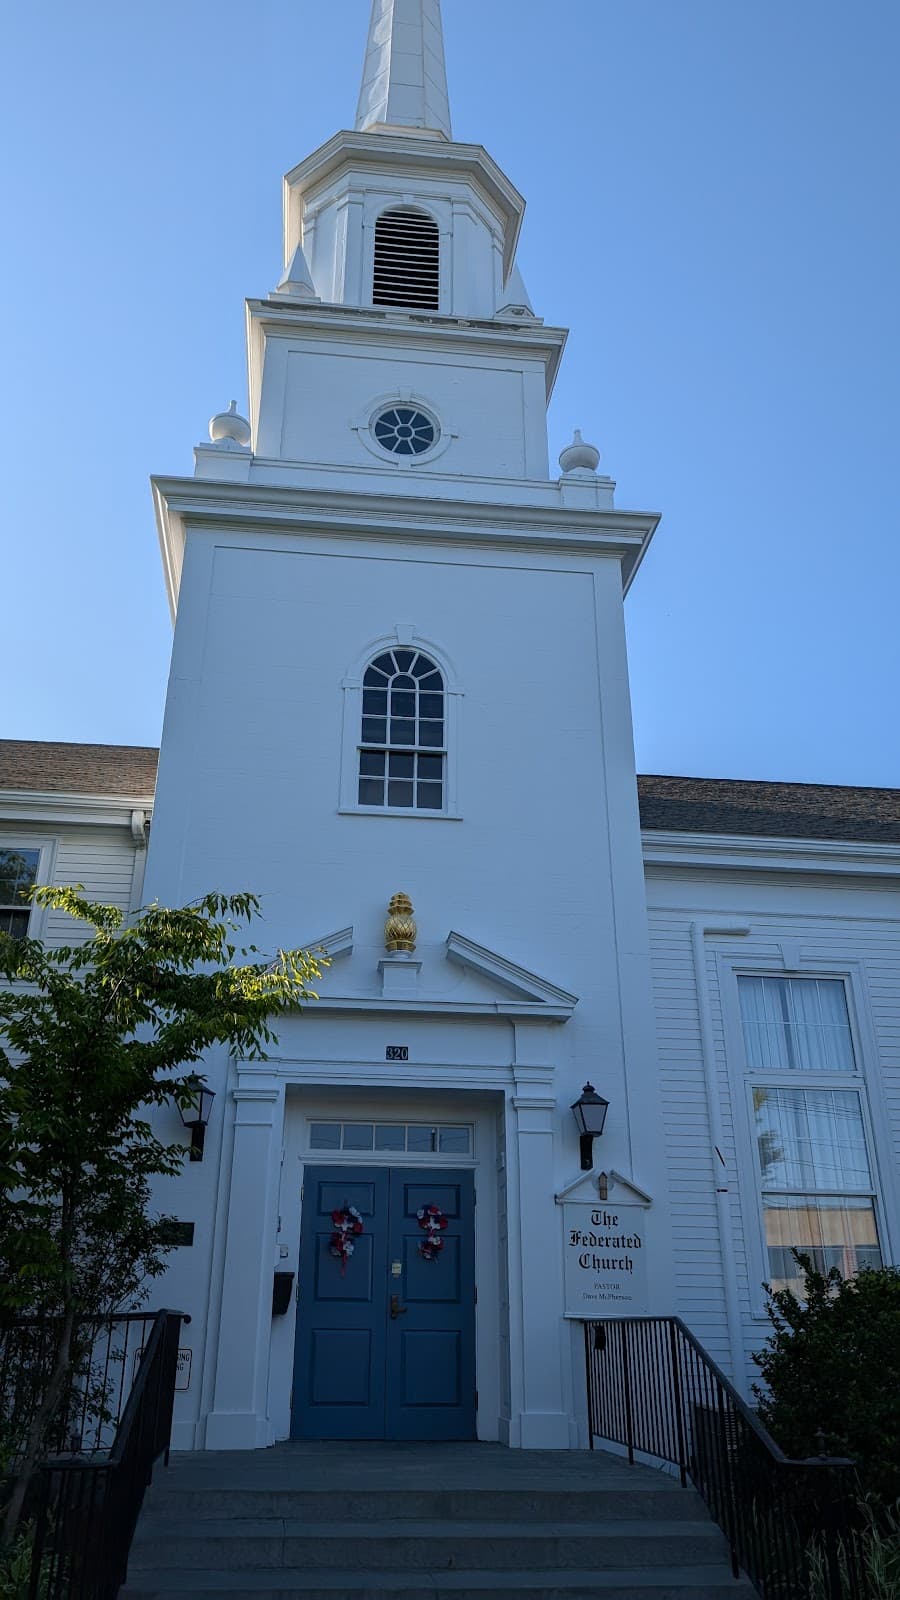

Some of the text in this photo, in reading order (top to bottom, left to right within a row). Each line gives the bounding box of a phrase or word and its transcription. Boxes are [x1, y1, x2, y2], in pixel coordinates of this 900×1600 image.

[387, 1047, 408, 1059] 320
[591, 1210, 618, 1229] The
[569, 1230, 641, 1248] Federated
[579, 1253, 632, 1274] Church
